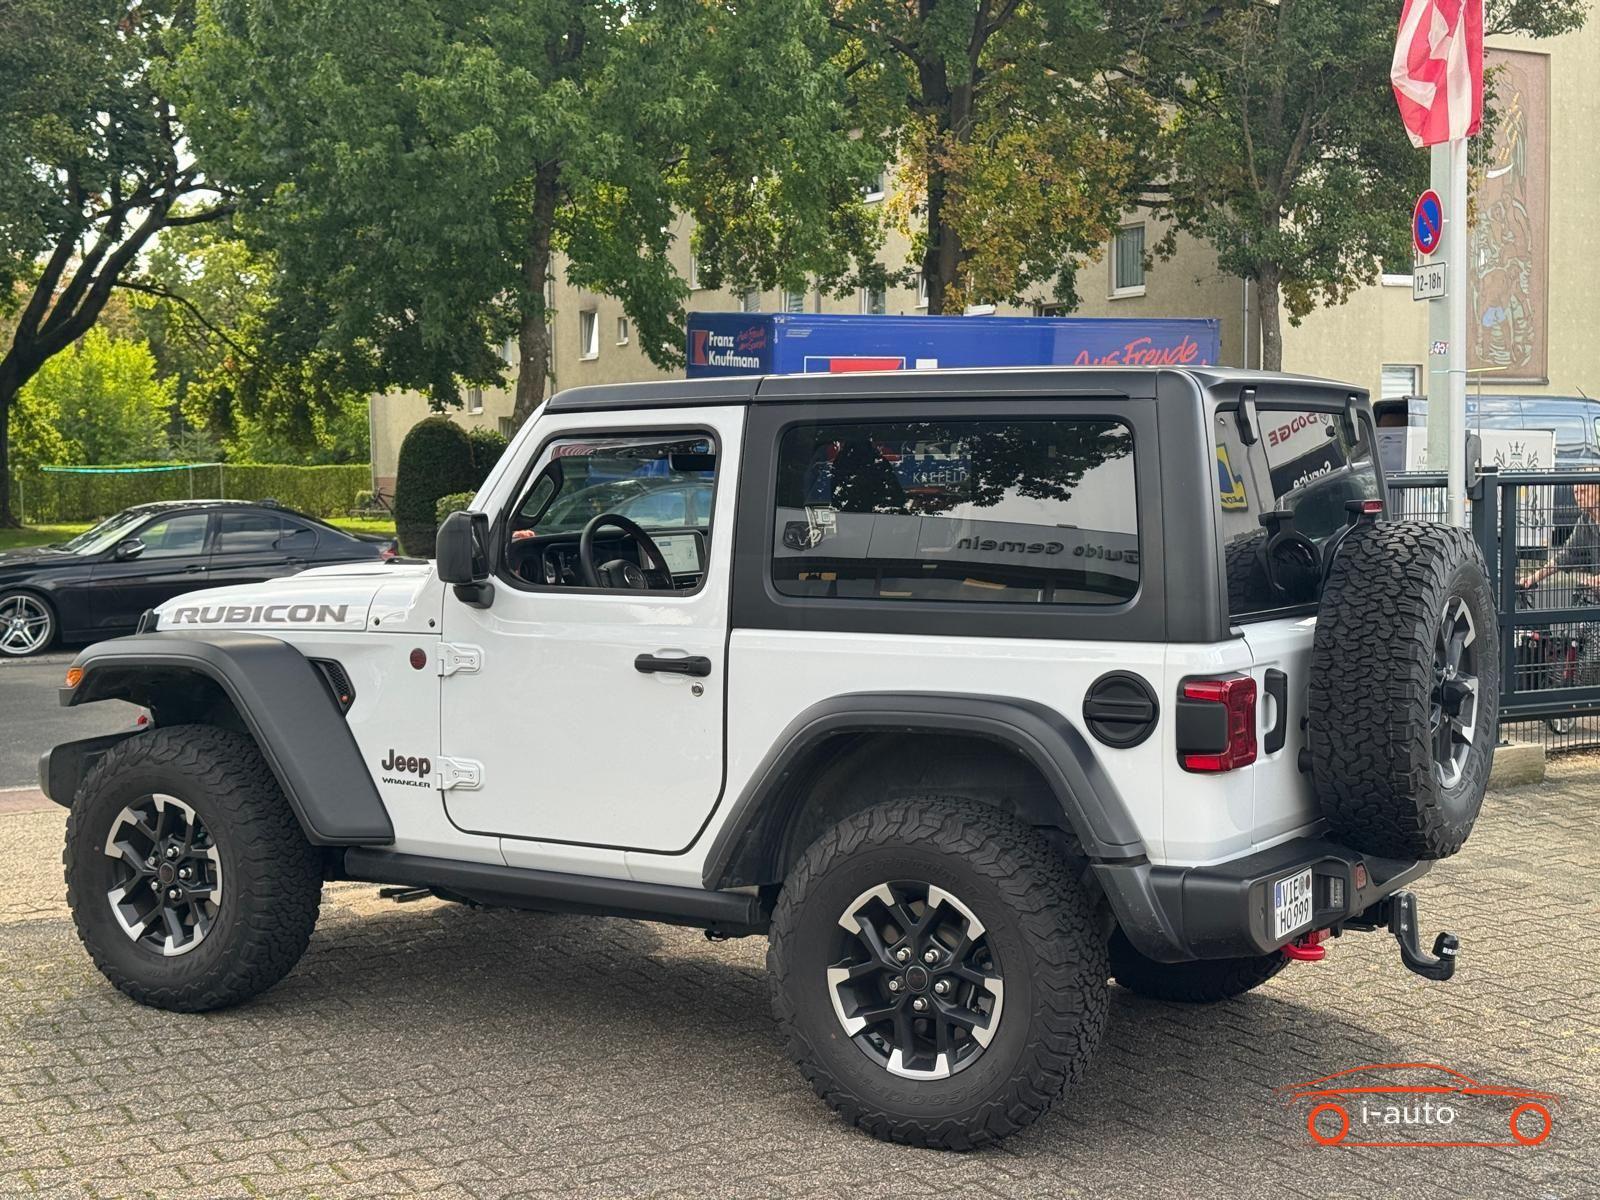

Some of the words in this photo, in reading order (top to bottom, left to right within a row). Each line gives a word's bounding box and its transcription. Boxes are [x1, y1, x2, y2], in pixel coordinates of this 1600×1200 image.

[1416, 272, 1442, 292] 12-18h
[708, 331, 735, 347] Franz
[708, 350, 760, 368] Knuffmann
[171, 604, 349, 624] RUBICON
[381, 748, 431, 778] Jeep
[381, 776, 431, 788] WRANGLER
[1282, 877, 1299, 907] VIE
